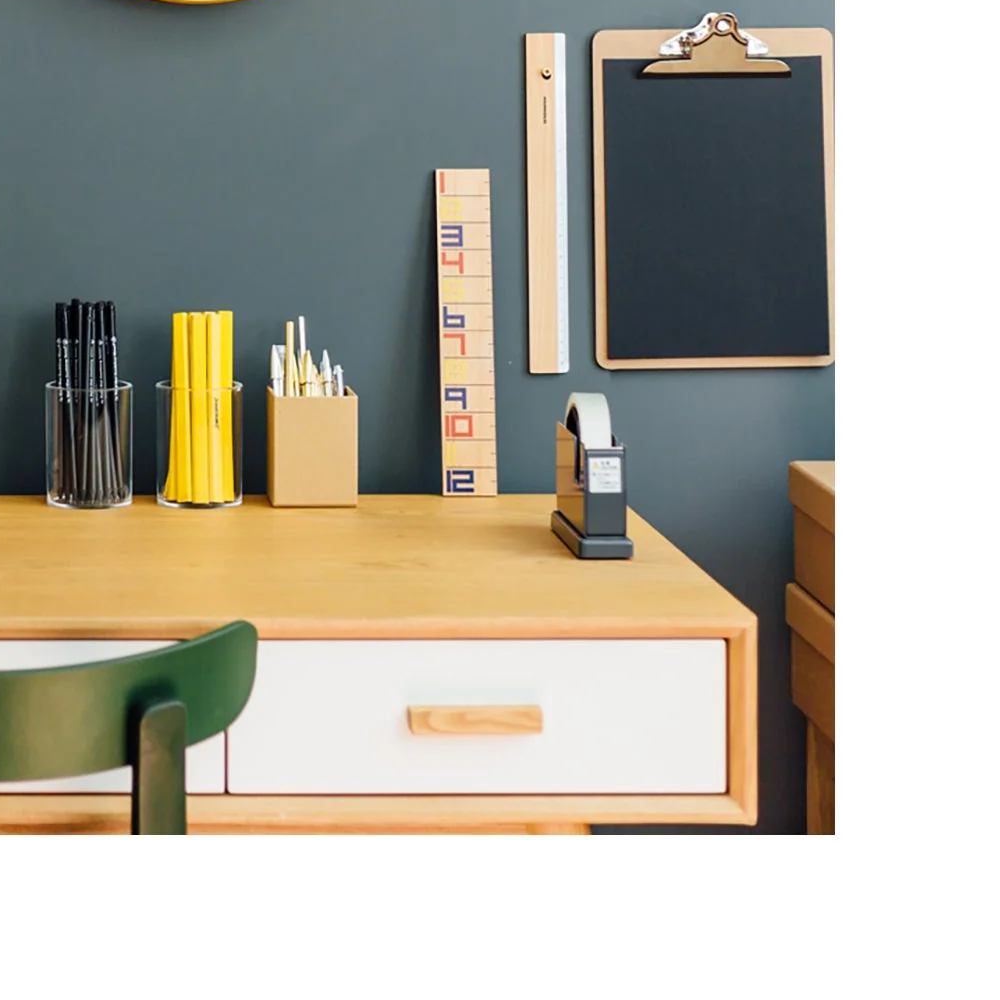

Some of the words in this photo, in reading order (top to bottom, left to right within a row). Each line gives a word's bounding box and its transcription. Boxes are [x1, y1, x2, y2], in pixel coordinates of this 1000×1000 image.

[441, 225, 463, 247] 3
[441, 252, 464, 274] 4
[443, 306, 465, 328] 6
[443, 333, 466, 355] 7
[444, 388, 467, 410] 9
[445, 415, 473, 437] 10
[446, 470, 474, 493] 12
